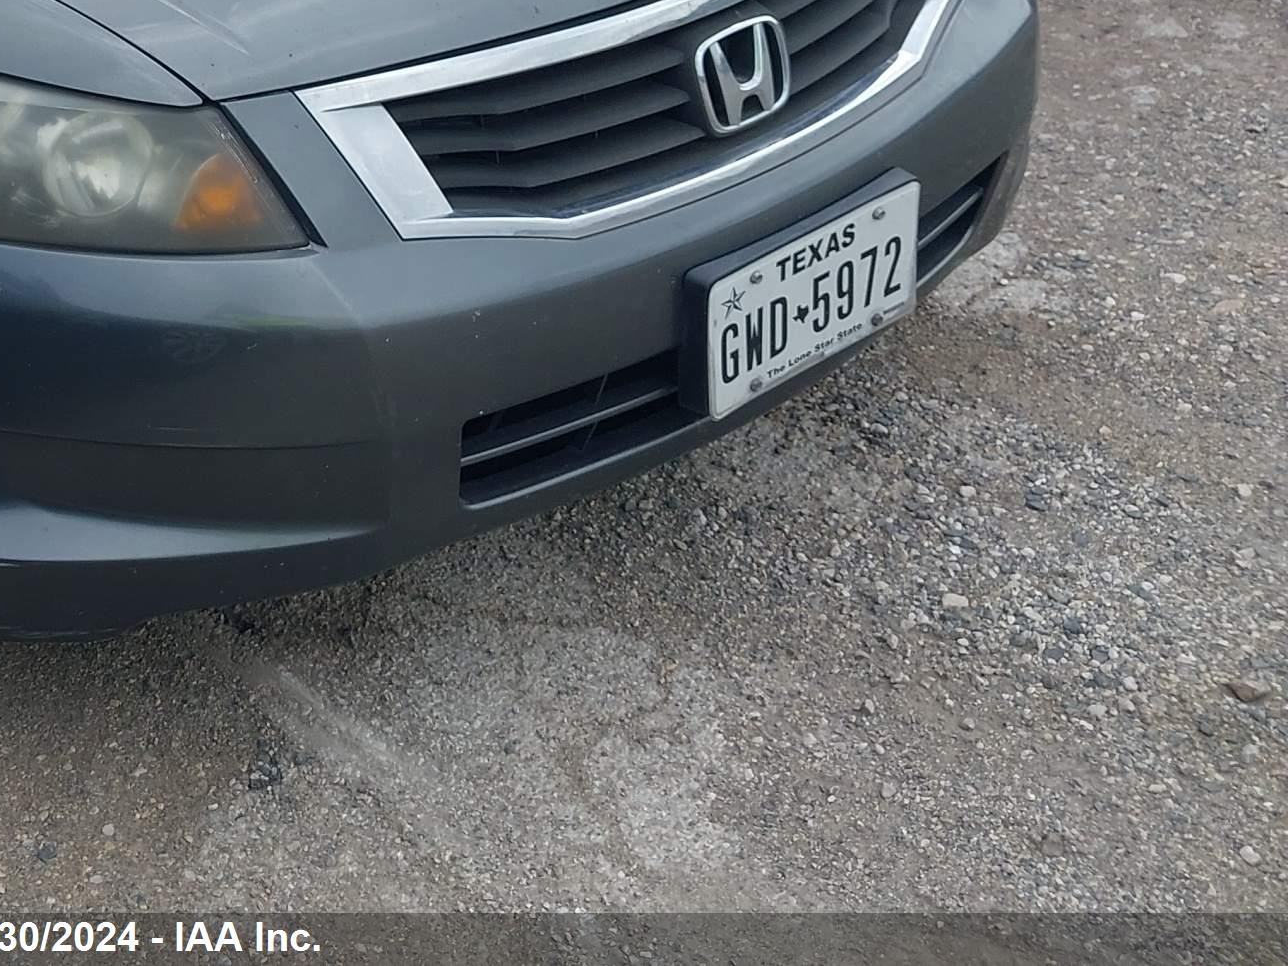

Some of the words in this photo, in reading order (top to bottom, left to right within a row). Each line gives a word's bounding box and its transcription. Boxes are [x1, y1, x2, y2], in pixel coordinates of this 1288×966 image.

[775, 223, 856, 282] TEXAS
[721, 296, 788, 385] GWD
[811, 236, 902, 333] 5972
[767, 364, 787, 379] The
[788, 348, 812, 368] Lone
[814, 336, 835, 352] Star
[836, 322, 863, 341] State
